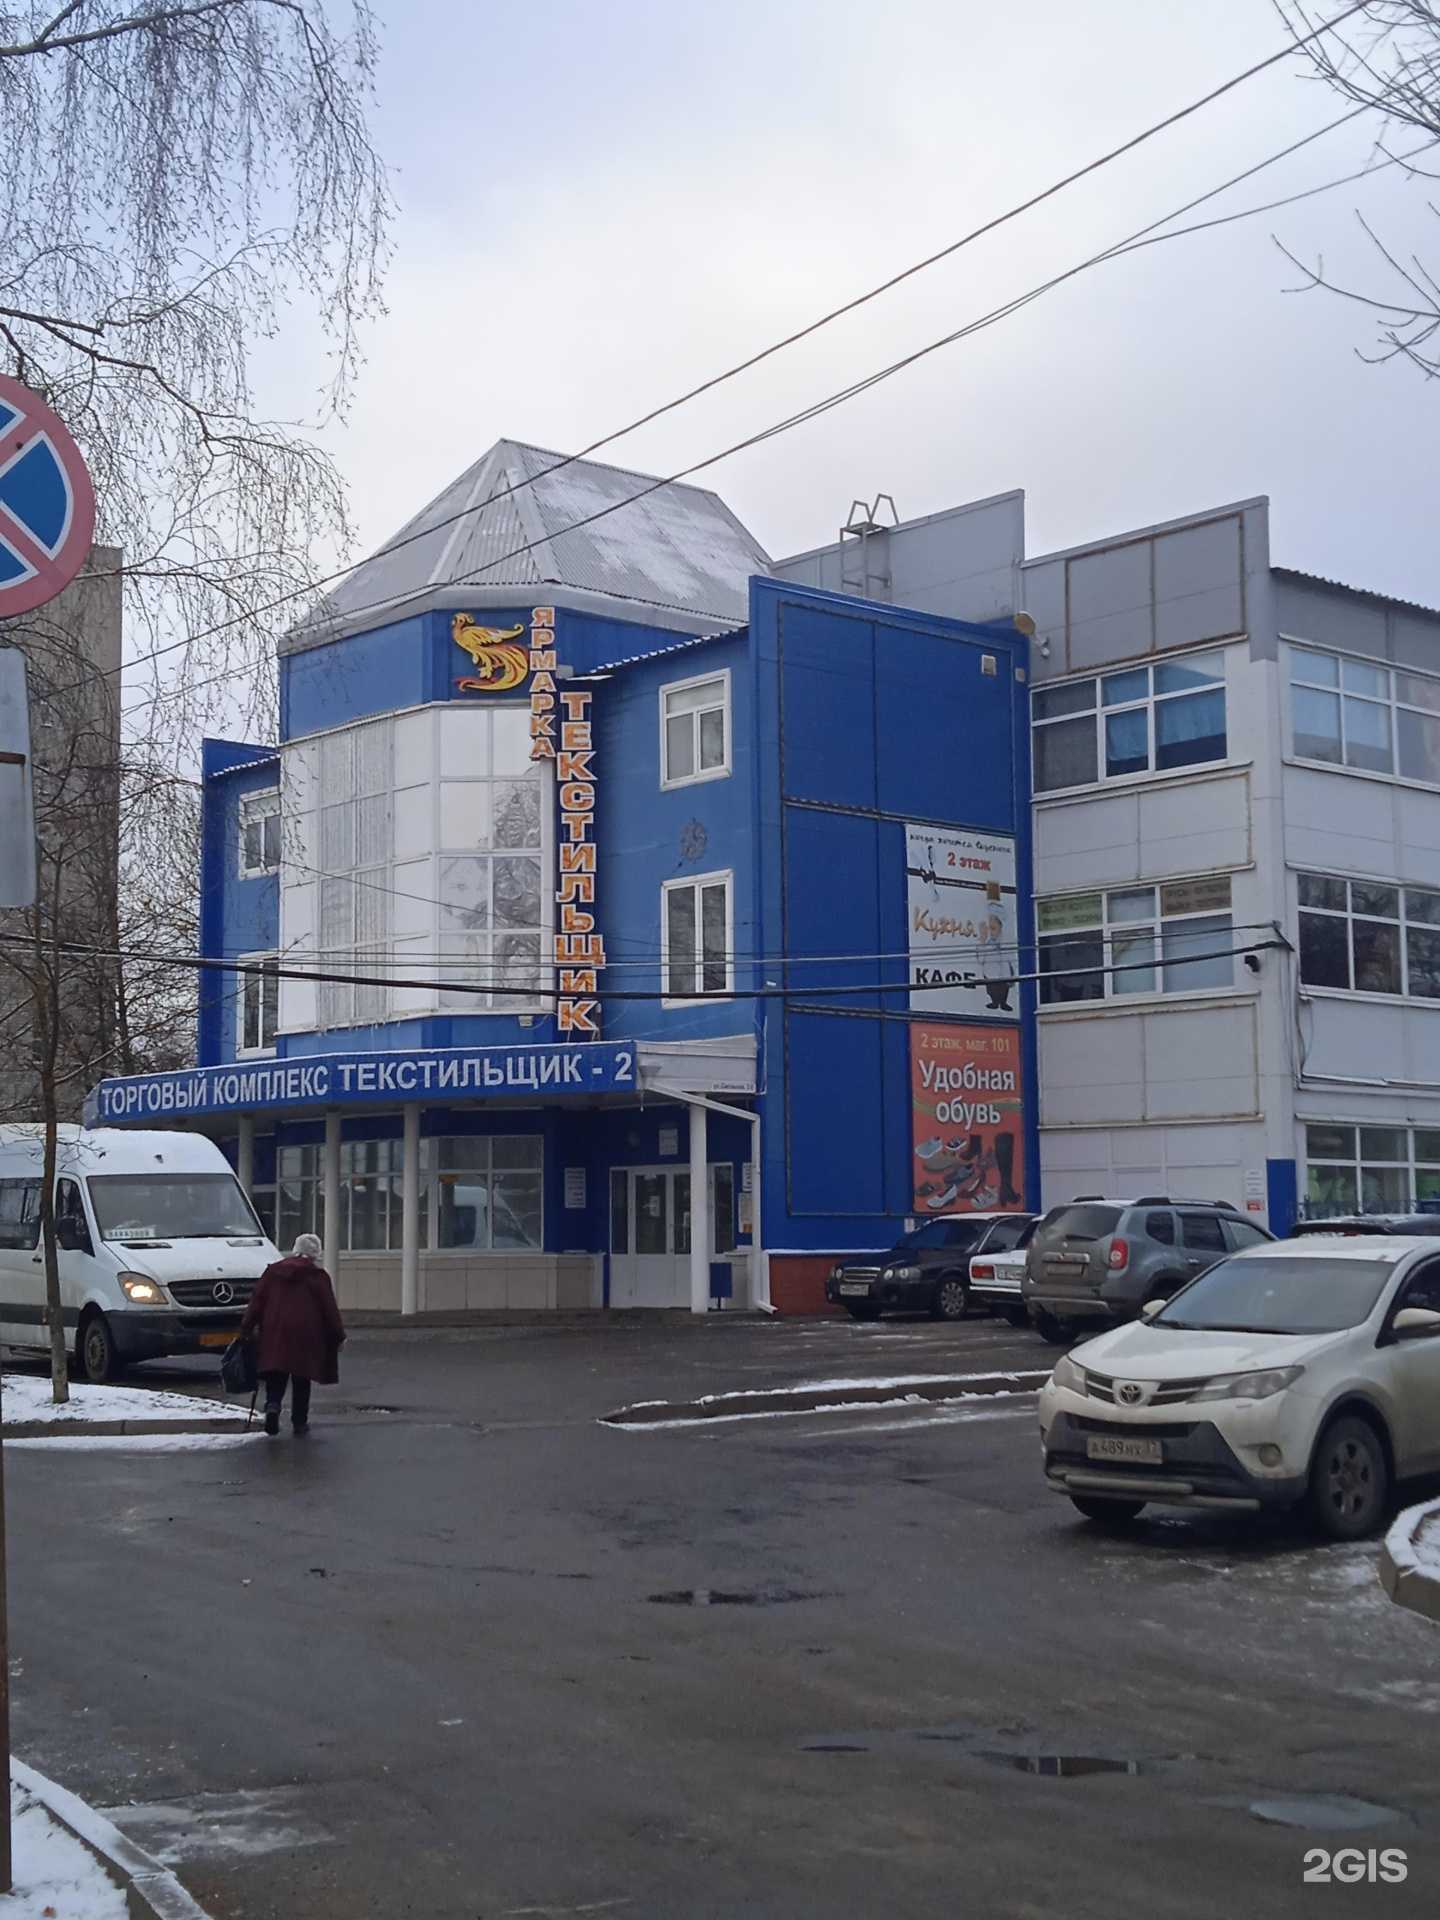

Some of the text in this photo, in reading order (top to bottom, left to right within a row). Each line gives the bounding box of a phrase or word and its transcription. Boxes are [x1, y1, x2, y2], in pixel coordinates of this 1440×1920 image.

[529, 606, 557, 760] ЯРМАРКА
[553, 691, 606, 1031] ТЕКСТИЛЬЩИК
[947, 852, 991, 871] 2 этаж
[915, 967, 977, 989] КАФЕ
[921, 1033, 929, 1048] 2
[992, 1038, 1010, 1052] 101
[102, 1072, 201, 1115] ТОРГОВЫЙ
[213, 1065, 329, 1105] КОМПЛЕКС
[337, 1053, 583, 1092] ТЕКСТИЛЬЩИК
[614, 1051, 633, 1081] 2
[918, 1059, 1016, 1093] Удобная
[936, 1095, 1001, 1130] обувь
